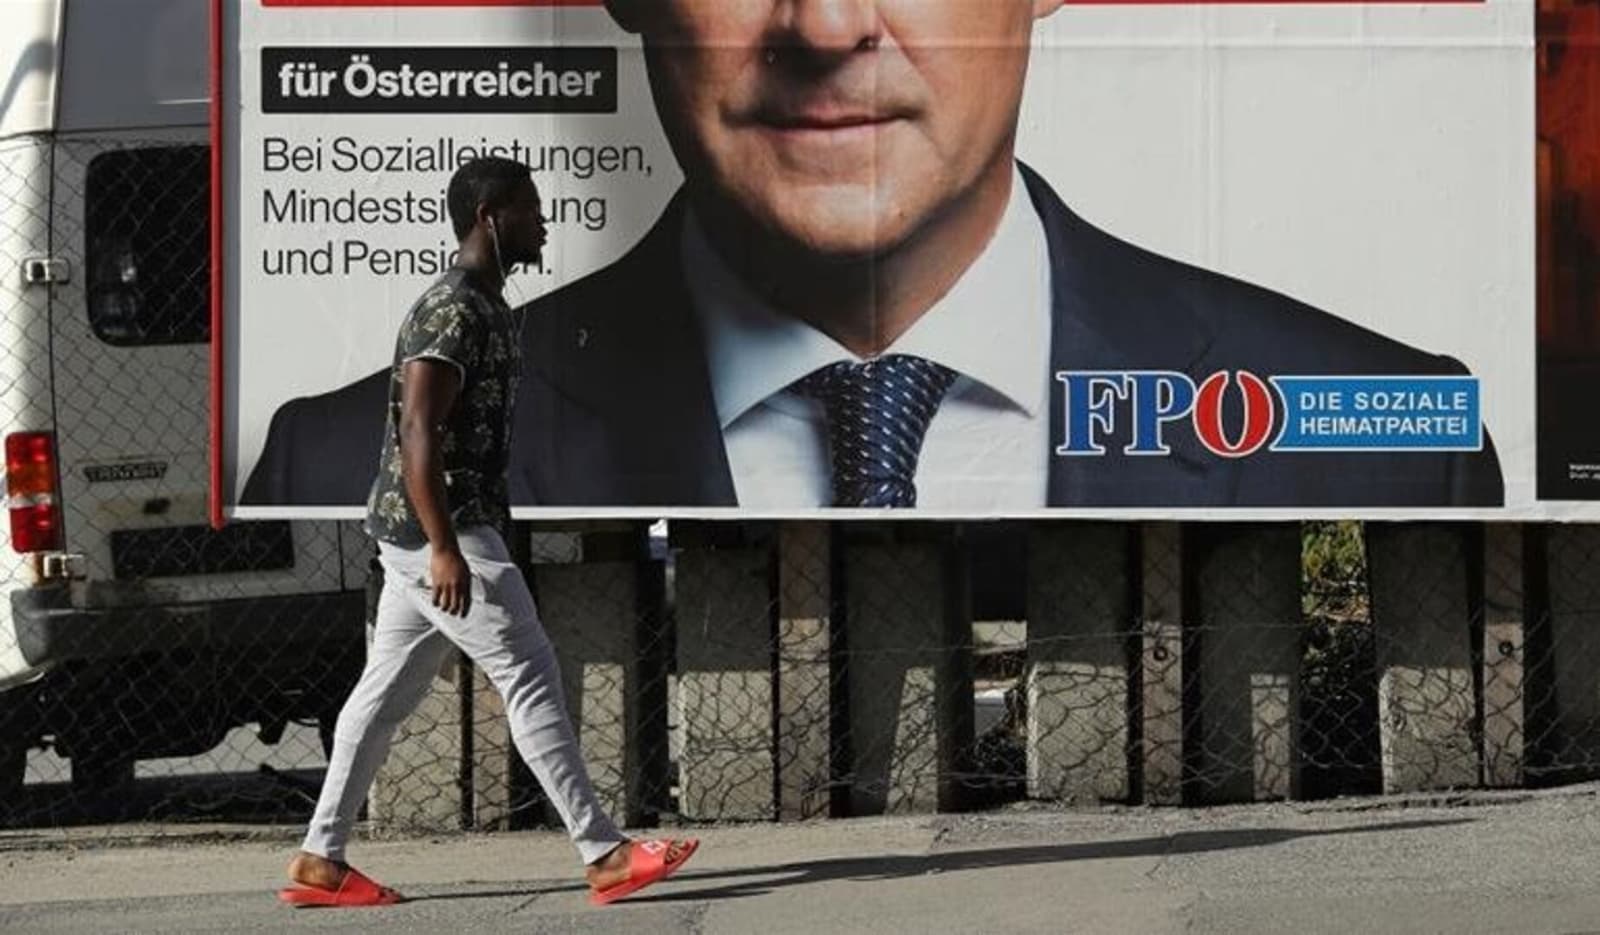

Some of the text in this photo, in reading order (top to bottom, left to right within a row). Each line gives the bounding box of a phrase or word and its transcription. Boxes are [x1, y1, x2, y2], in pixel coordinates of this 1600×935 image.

[278, 54, 602, 98] für Österreicher
[263, 137, 322, 172] Bei
[263, 188, 607, 231] Mindestsiung
[263, 241, 333, 275] und
[1300, 391, 1468, 411] DIE SOZIALE
[1300, 416, 1467, 435] HEIMATPARTEI
